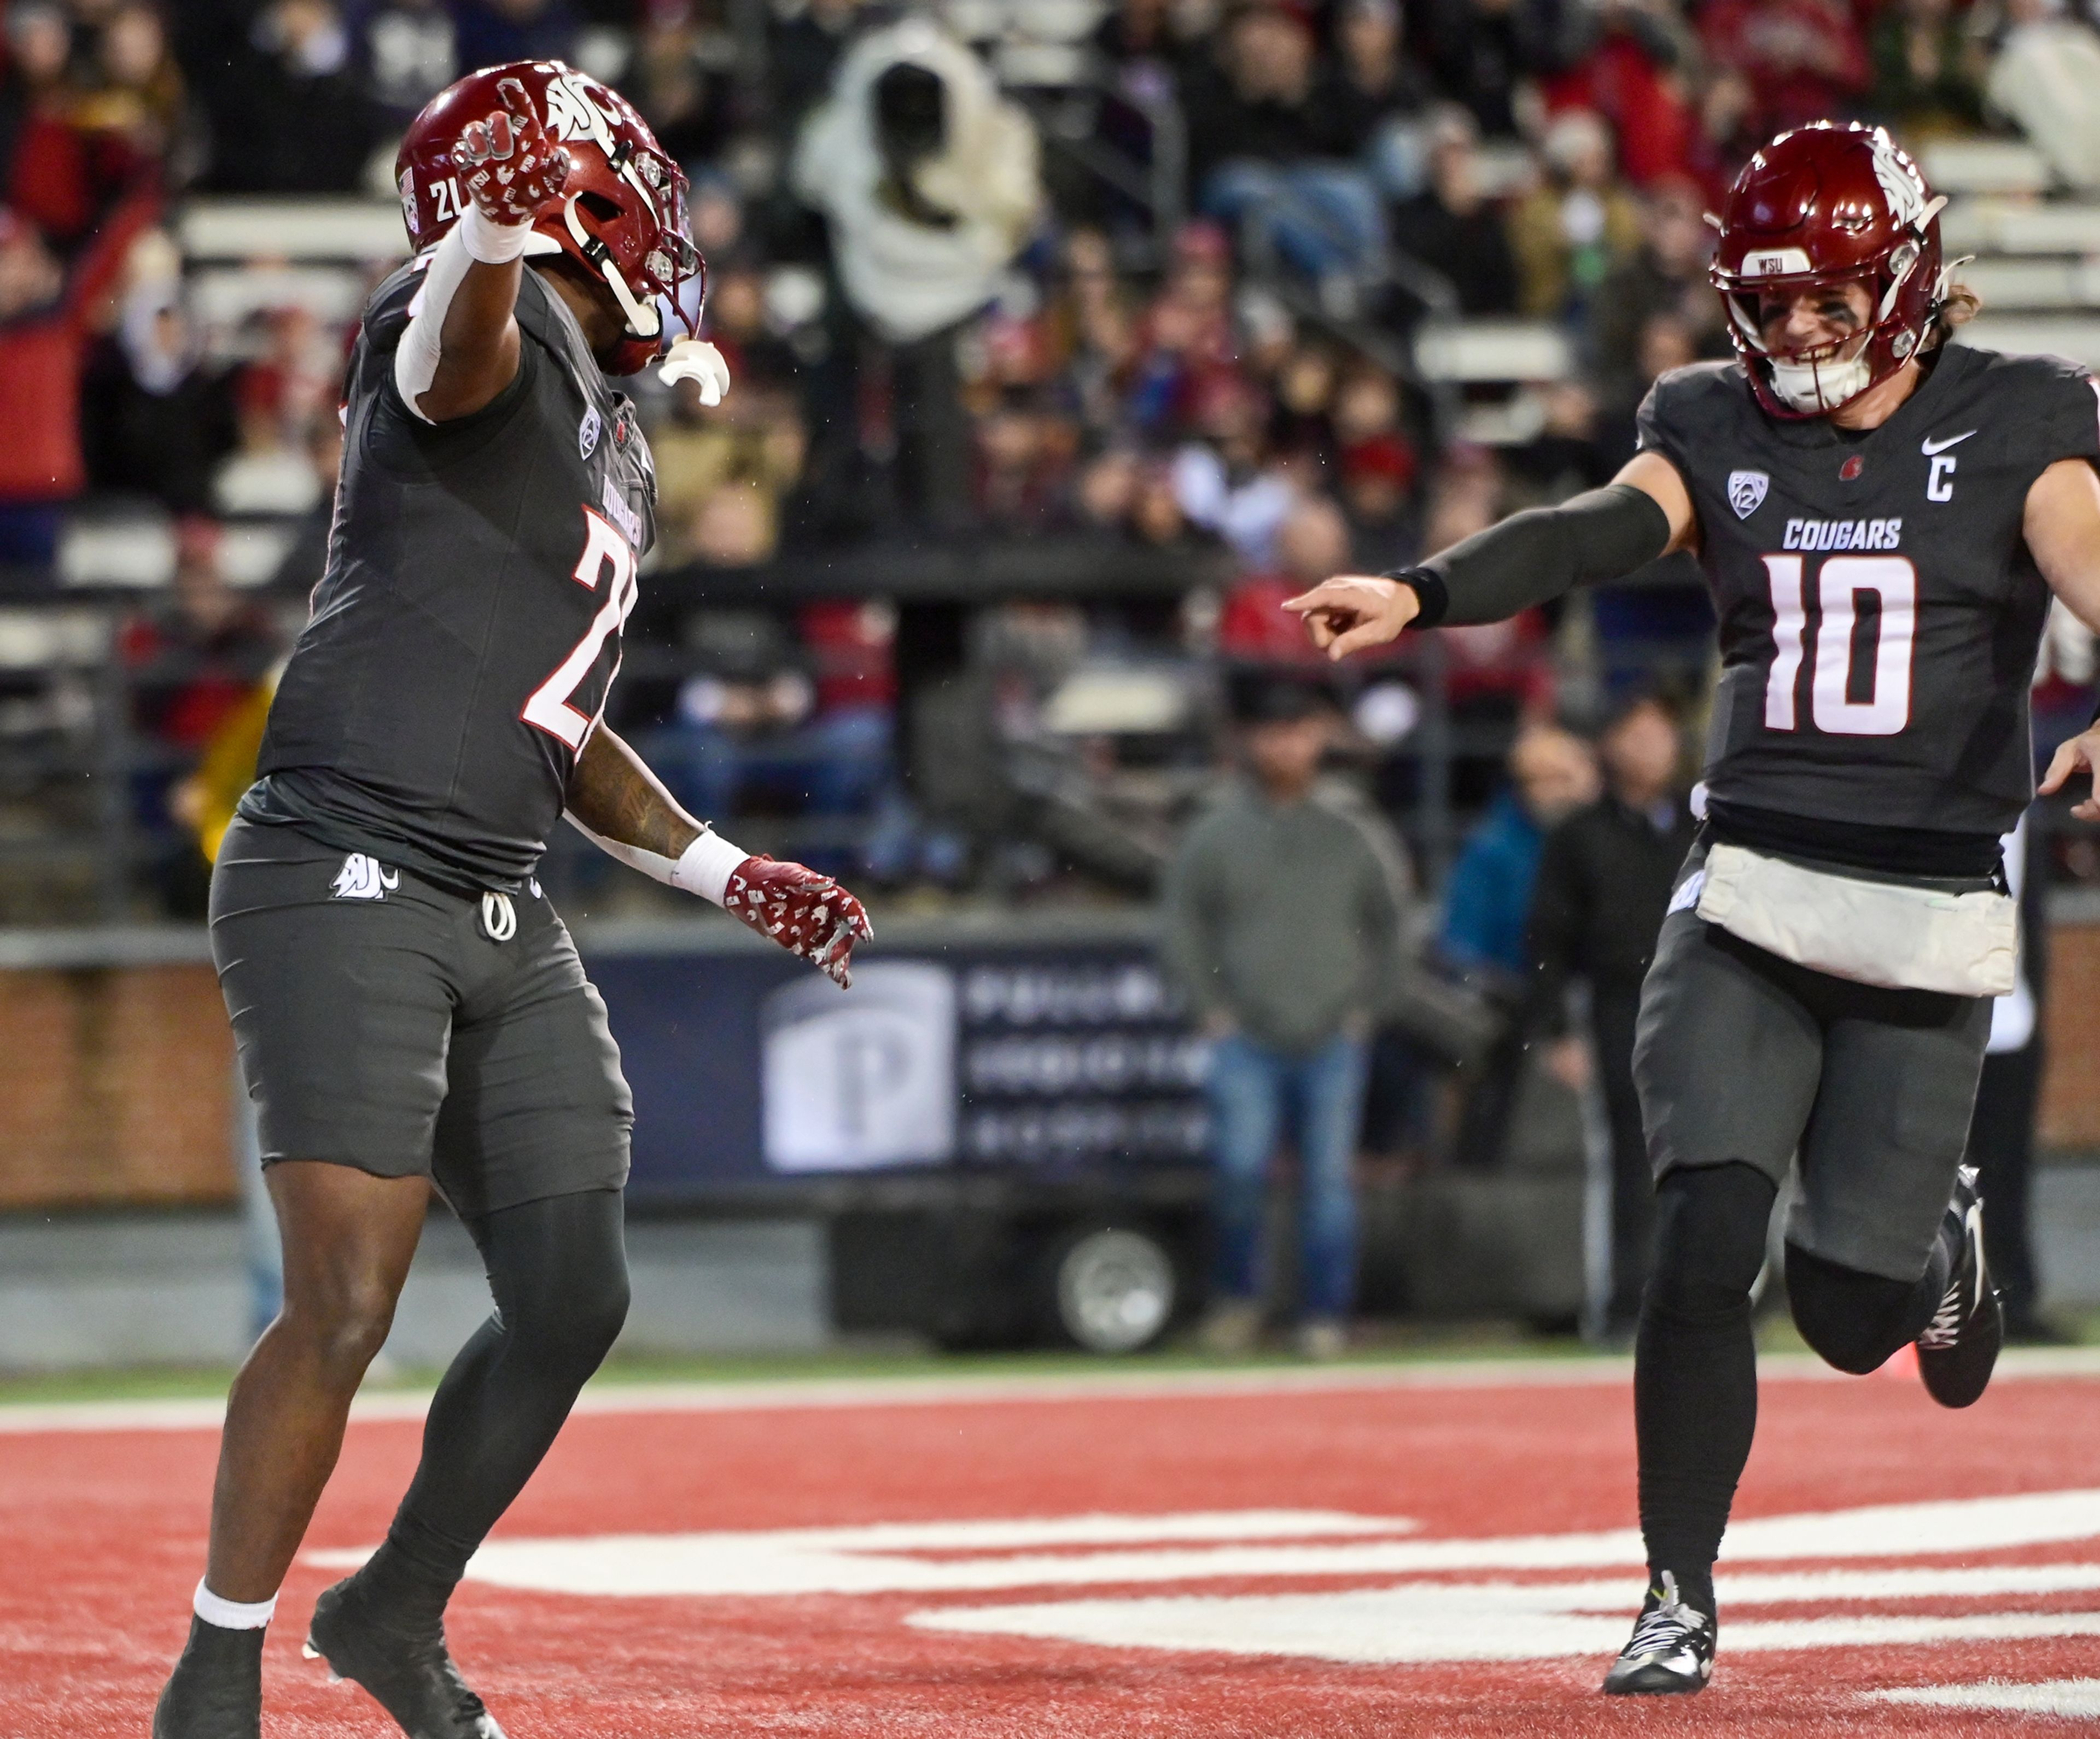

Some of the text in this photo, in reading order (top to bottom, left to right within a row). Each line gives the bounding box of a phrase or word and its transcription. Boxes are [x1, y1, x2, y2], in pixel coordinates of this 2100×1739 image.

[429, 177, 463, 222] 21
[1758, 258, 1783, 275] WSU
[1927, 456, 1956, 502] C
[1736, 490, 1756, 509] 12
[1783, 517, 1903, 551] COUGARS
[1760, 553, 1918, 737] 10
